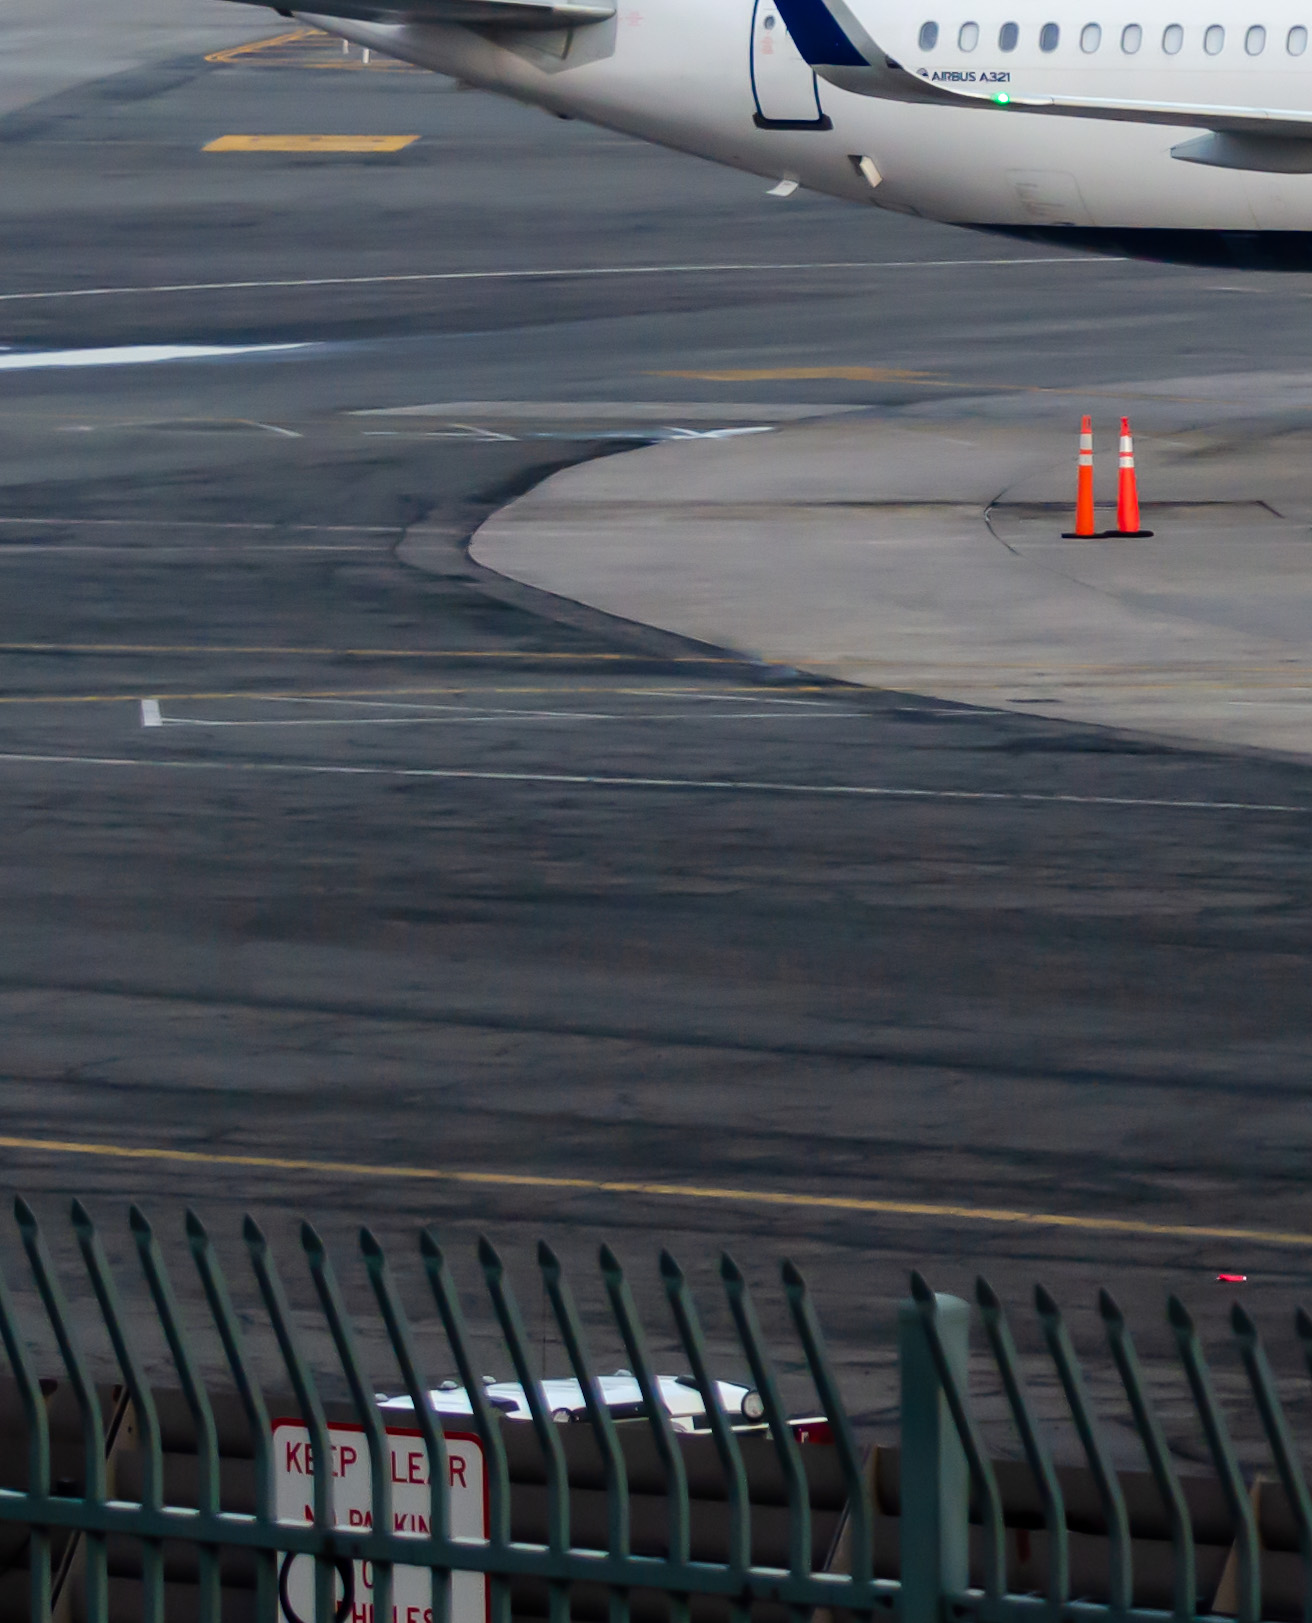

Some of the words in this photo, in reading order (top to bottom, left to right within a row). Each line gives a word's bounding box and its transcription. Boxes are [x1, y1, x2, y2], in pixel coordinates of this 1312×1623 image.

[931, 71, 976, 82] AIRBUS
[979, 72, 1010, 82] A321
[390, 1450, 468, 1489] LER
